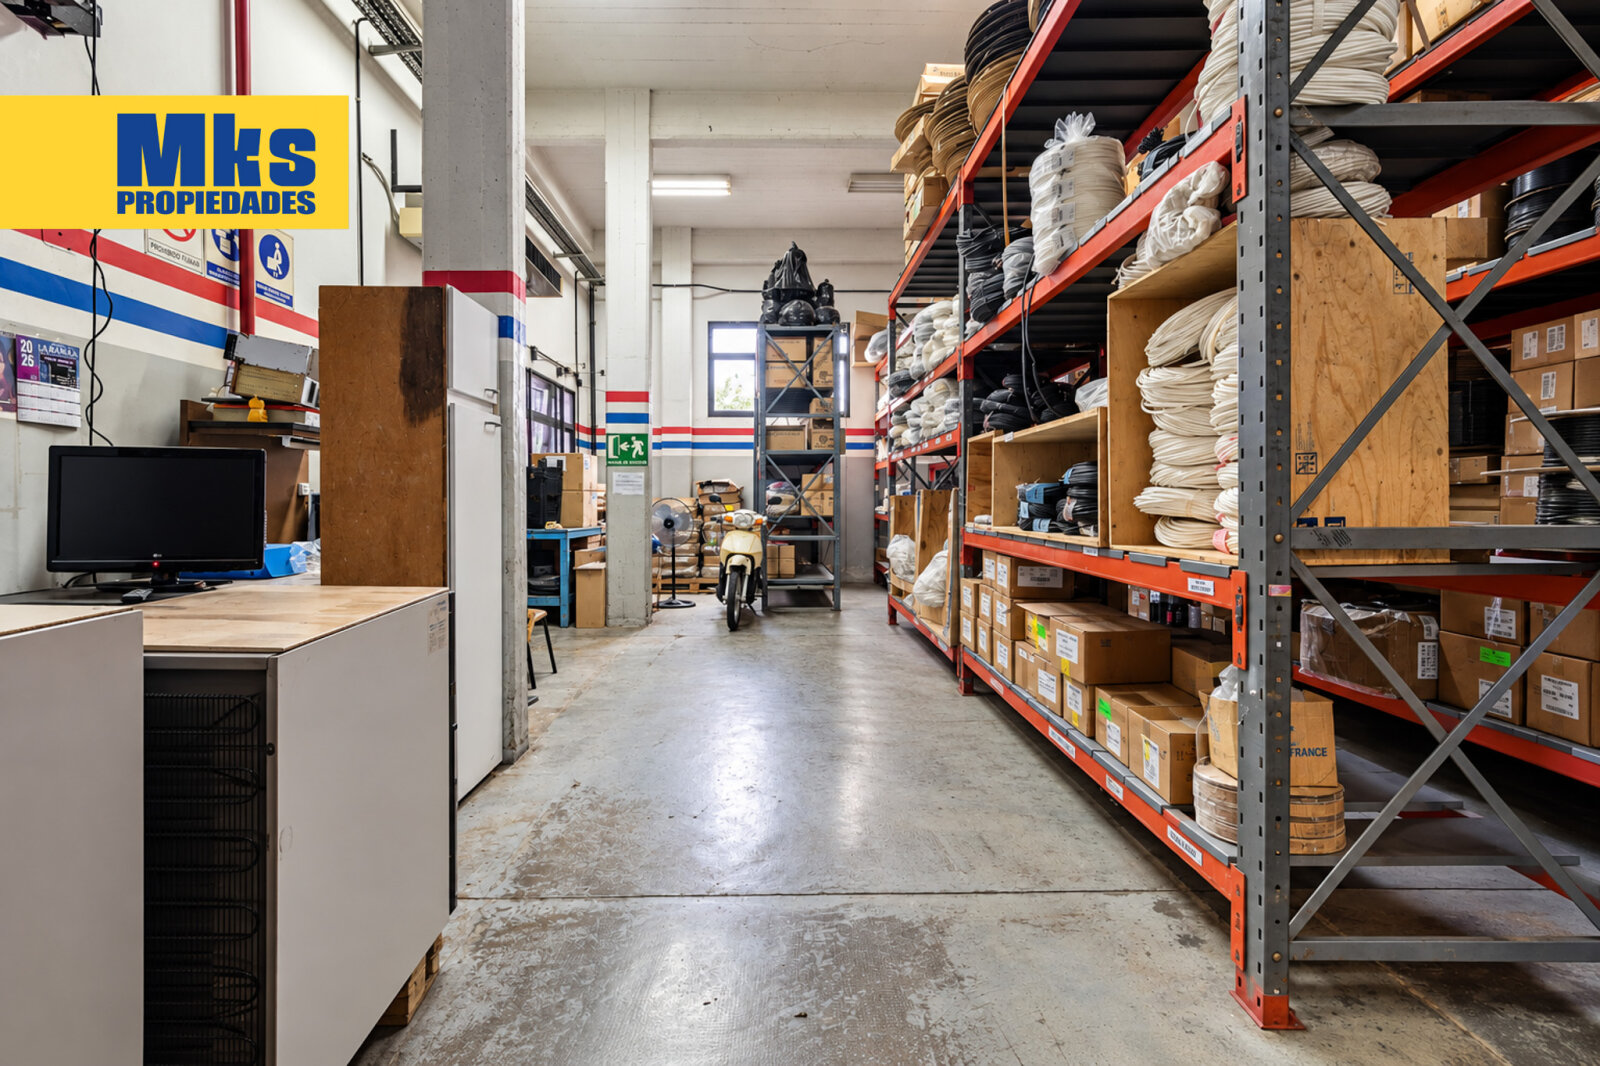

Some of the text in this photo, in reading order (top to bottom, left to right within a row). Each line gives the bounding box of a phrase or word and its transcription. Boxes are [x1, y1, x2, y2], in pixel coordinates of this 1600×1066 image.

[20, 339, 33, 354] 20
[21, 353, 35, 367] 26
[1290, 747, 1328, 758] FRANCE
